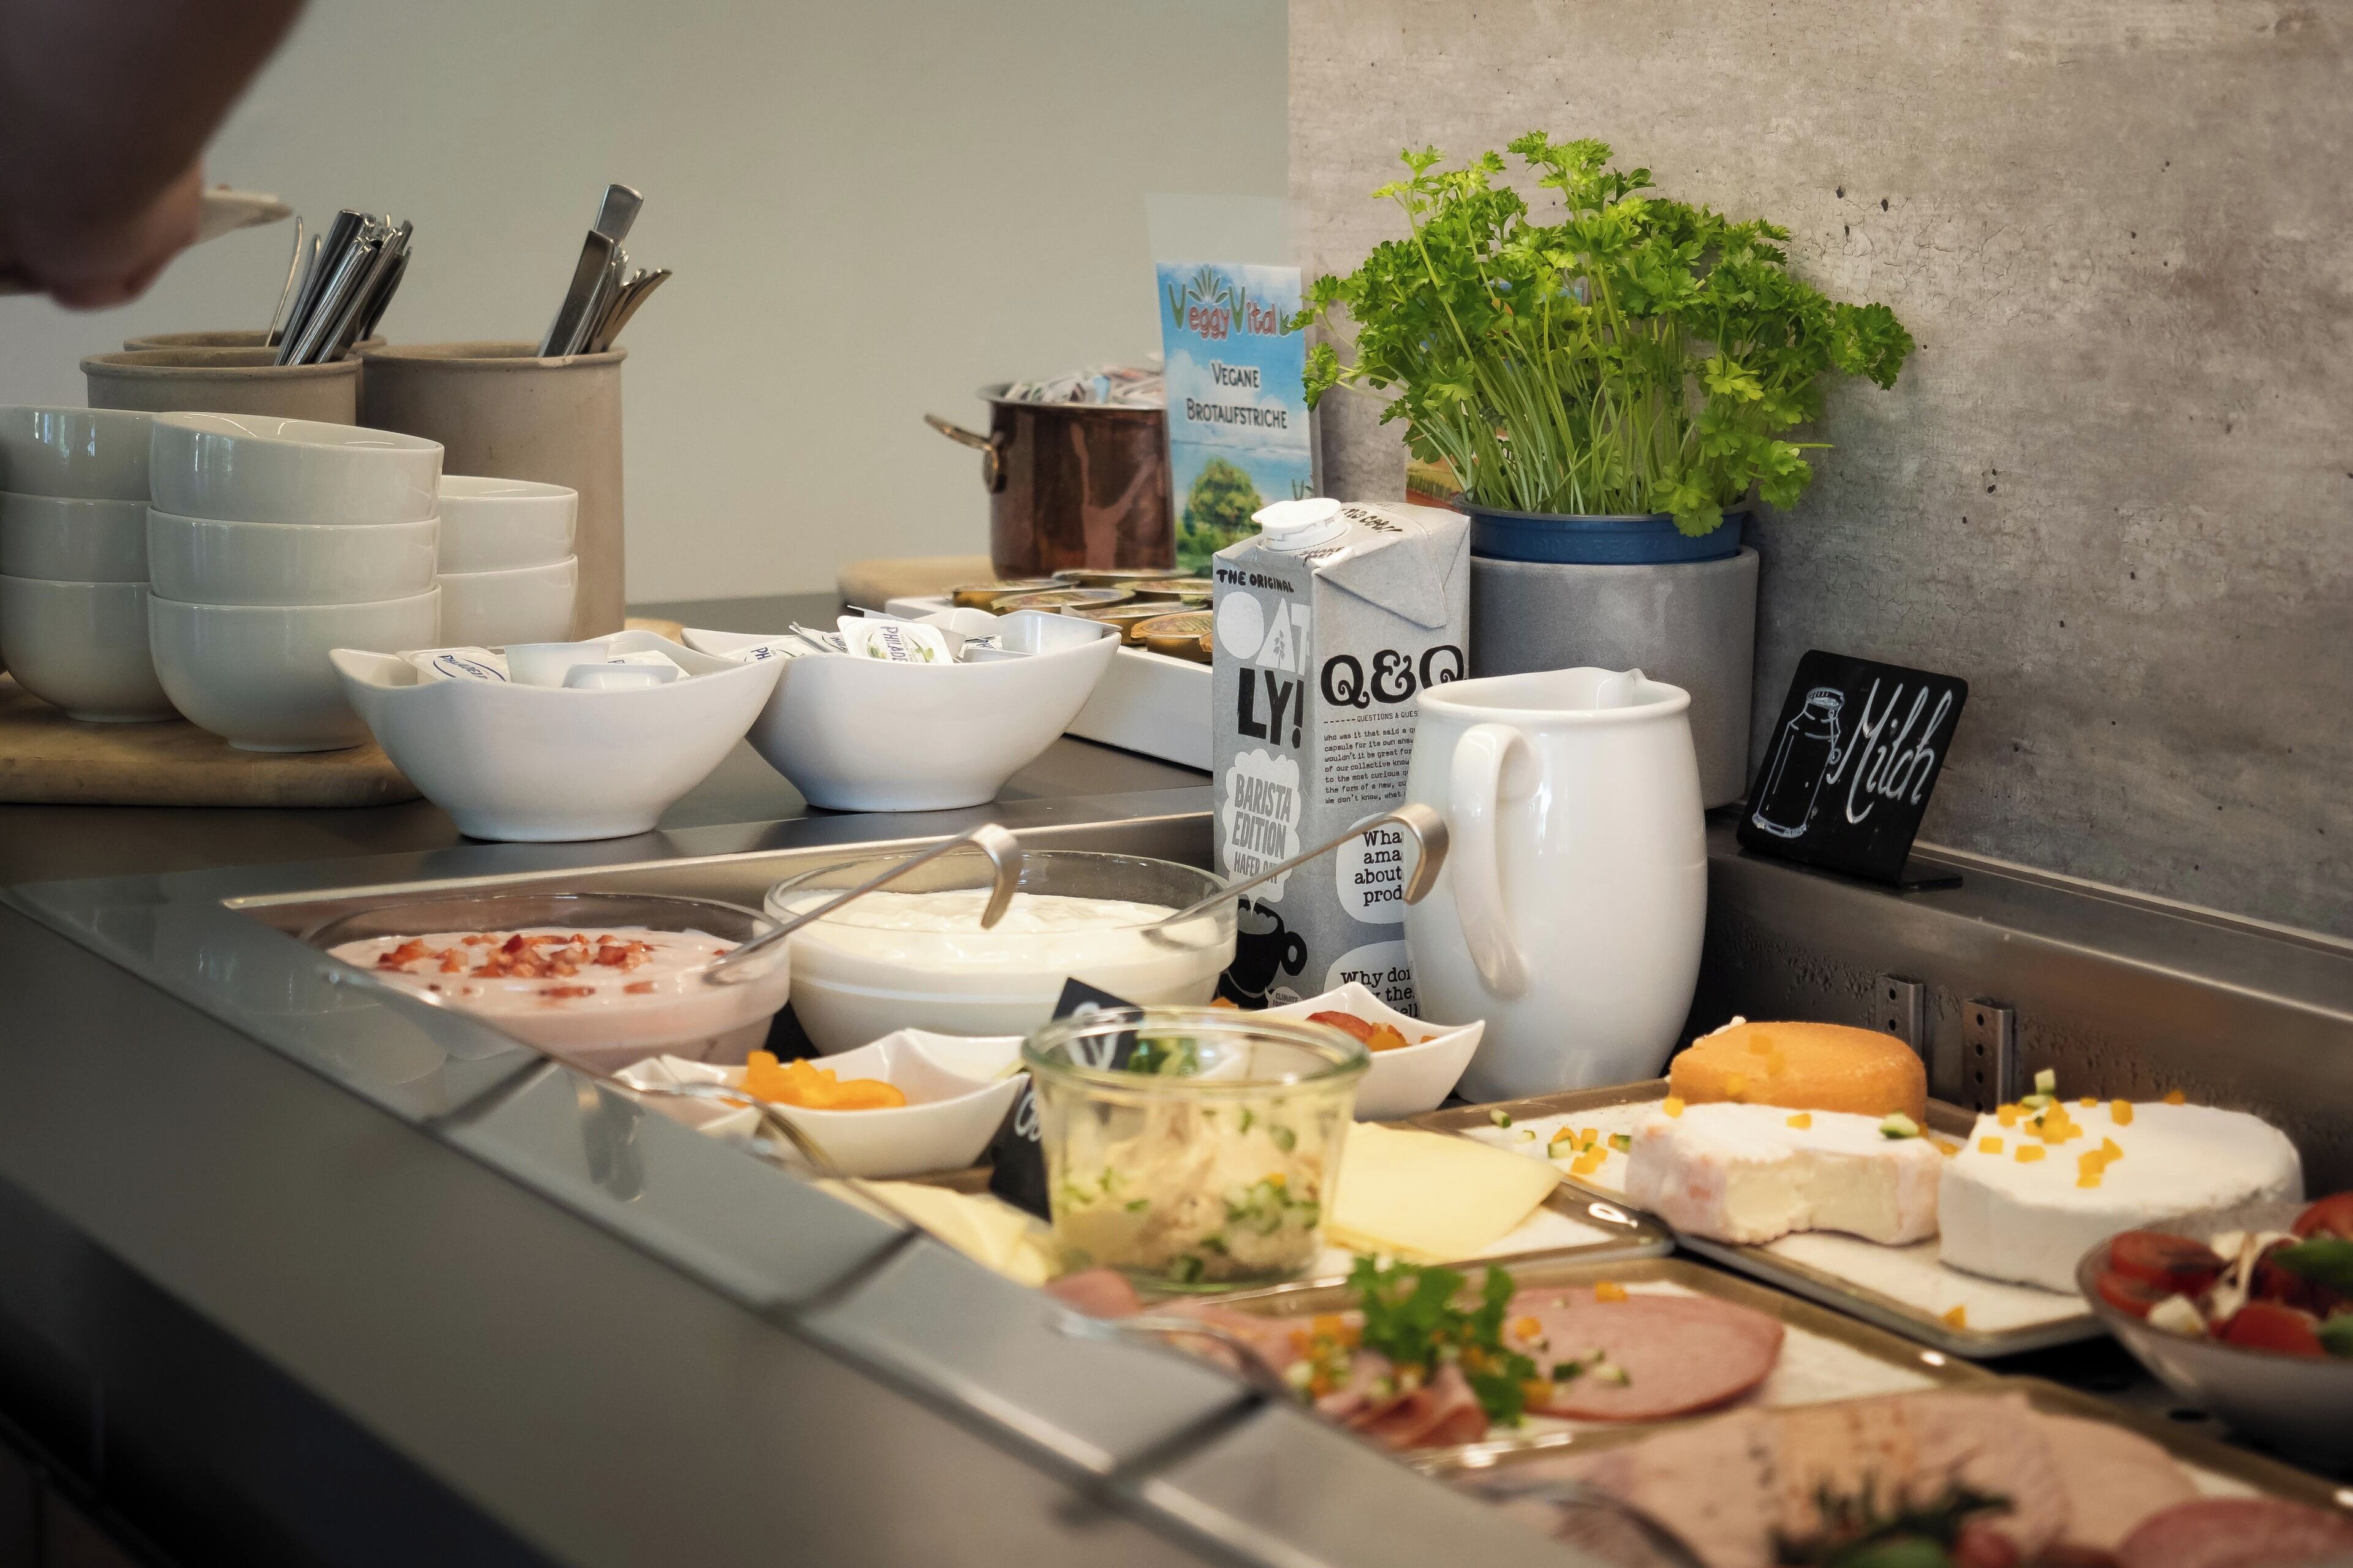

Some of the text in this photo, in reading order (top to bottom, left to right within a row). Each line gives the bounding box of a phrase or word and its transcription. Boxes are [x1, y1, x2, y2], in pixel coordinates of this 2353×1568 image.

[1211, 363, 1260, 388] VEGANE
[1186, 398, 1288, 429] BROTAUFSTRICHE
[1216, 569, 1295, 593] THE ORIGINAL
[1217, 591, 1311, 676] OAT
[1237, 667, 1305, 749] LY!
[1325, 752, 1356, 762] wouldn't
[1377, 749, 1398, 759] great
[1826, 677, 1953, 825] Milch
[1351, 760, 1391, 770] collective
[1371, 770, 1400, 779] curious
[1235, 773, 1293, 823] BARISTA
[1338, 794, 1358, 803] don't
[1232, 810, 1287, 860] EDITION
[1234, 851, 1260, 877] HAFER
[1363, 849, 1402, 865] ama
[1354, 866, 1402, 885] about
[1363, 884, 1403, 907] prod
[1340, 971, 1384, 988] Why
[1385, 986, 1415, 1002] the
[1393, 1003, 1418, 1018] ell
